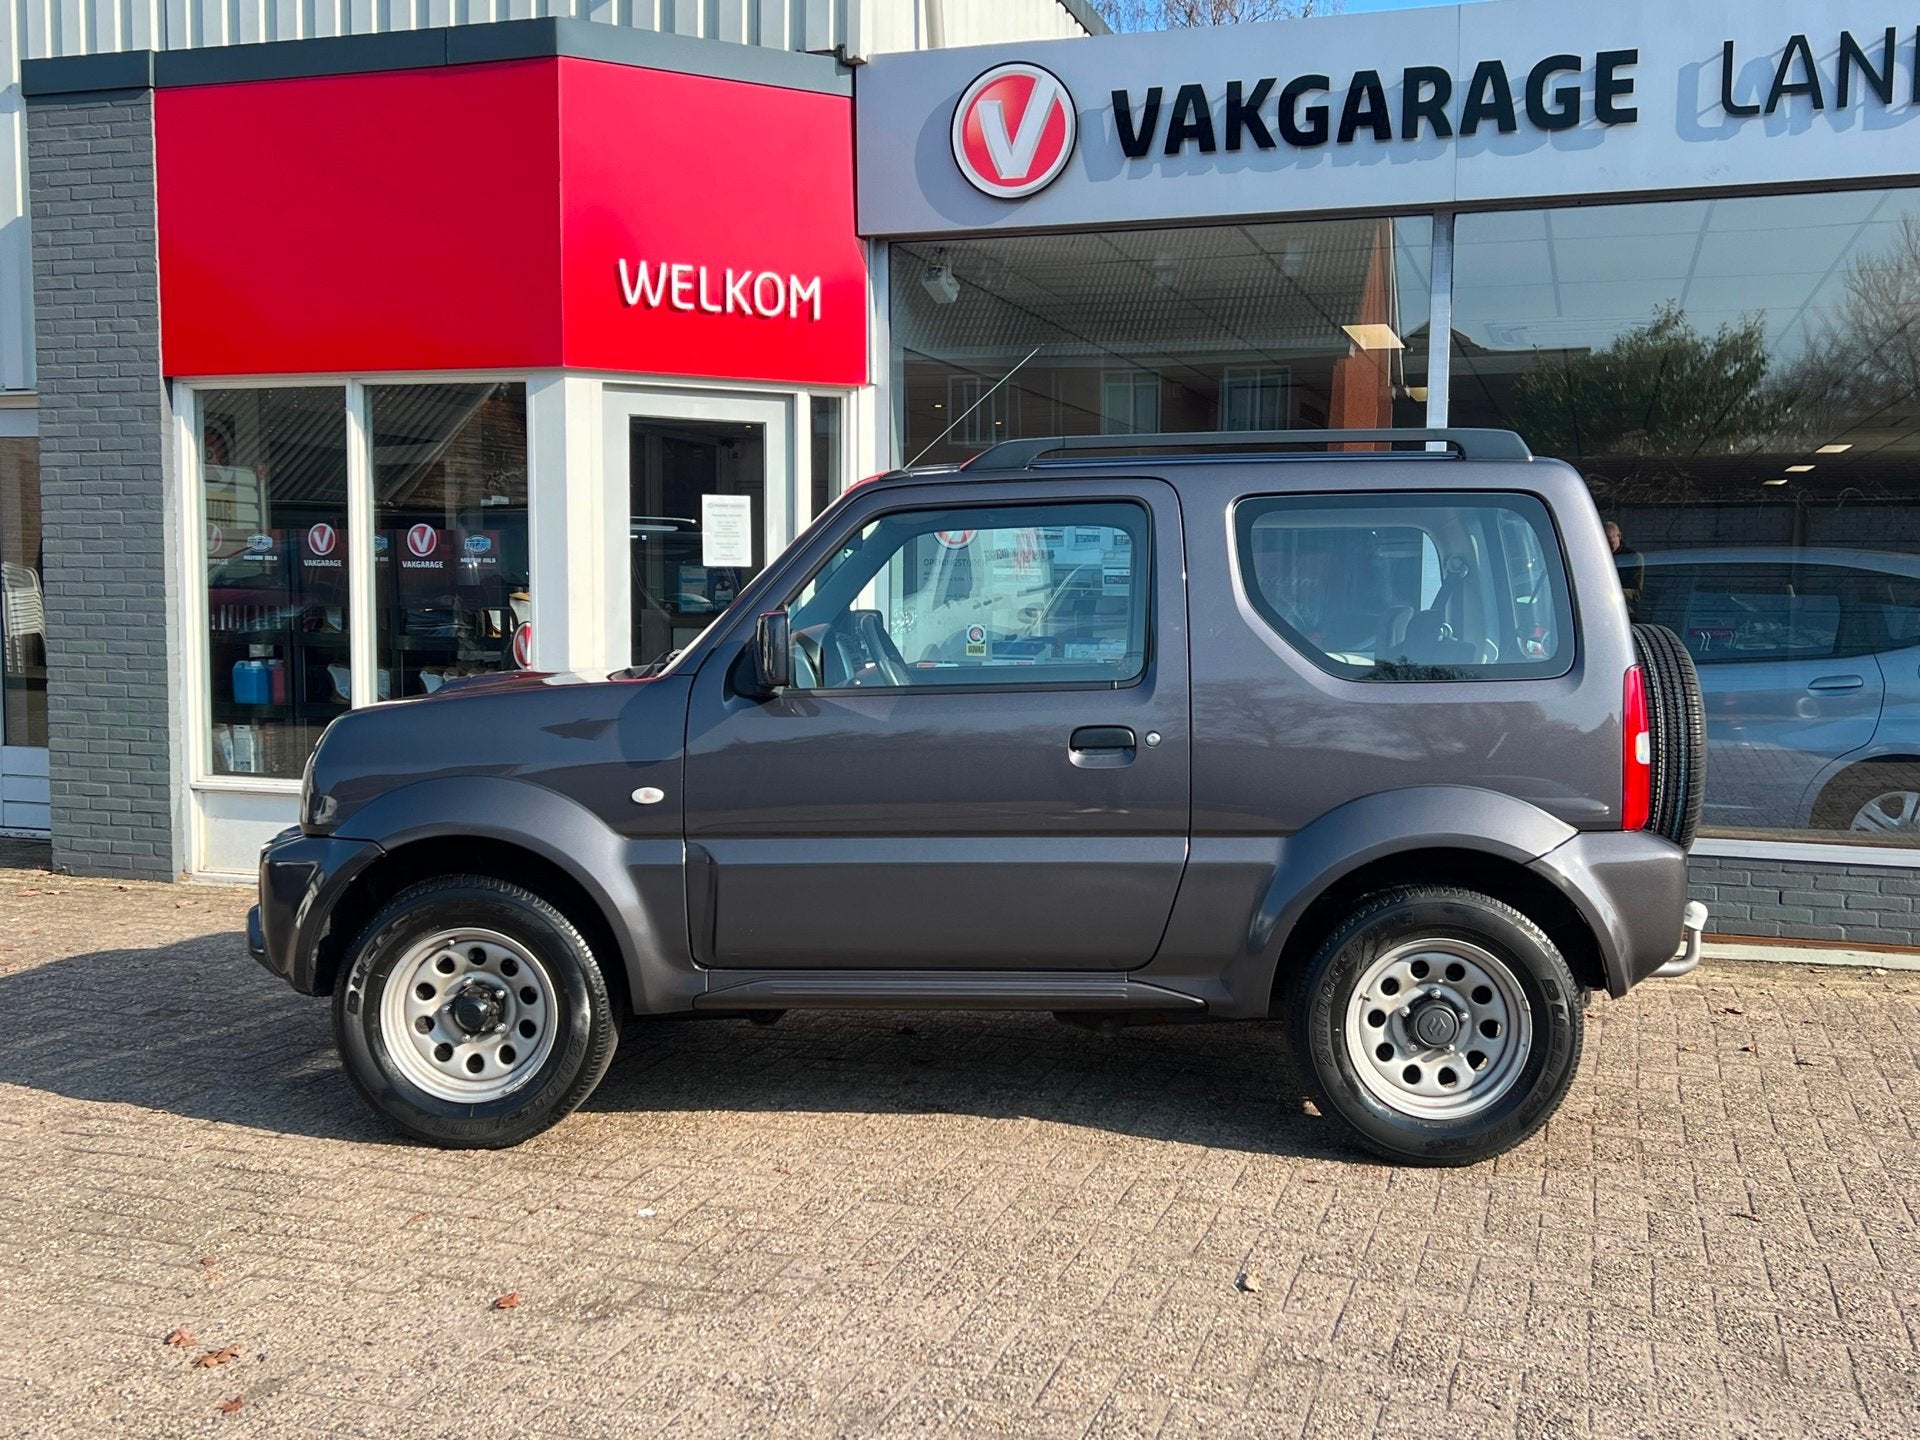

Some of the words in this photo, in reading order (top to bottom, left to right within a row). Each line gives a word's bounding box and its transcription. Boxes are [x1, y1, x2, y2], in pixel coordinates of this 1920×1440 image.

[974, 71, 1060, 181] V
[1111, 48, 1638, 158] VAKGARAGE
[1721, 25, 1920, 116] LAN
[618, 257, 821, 321] WELKOM
[303, 559, 342, 567] VAKGARAGE
[401, 560, 444, 569] VAKGARAGE
